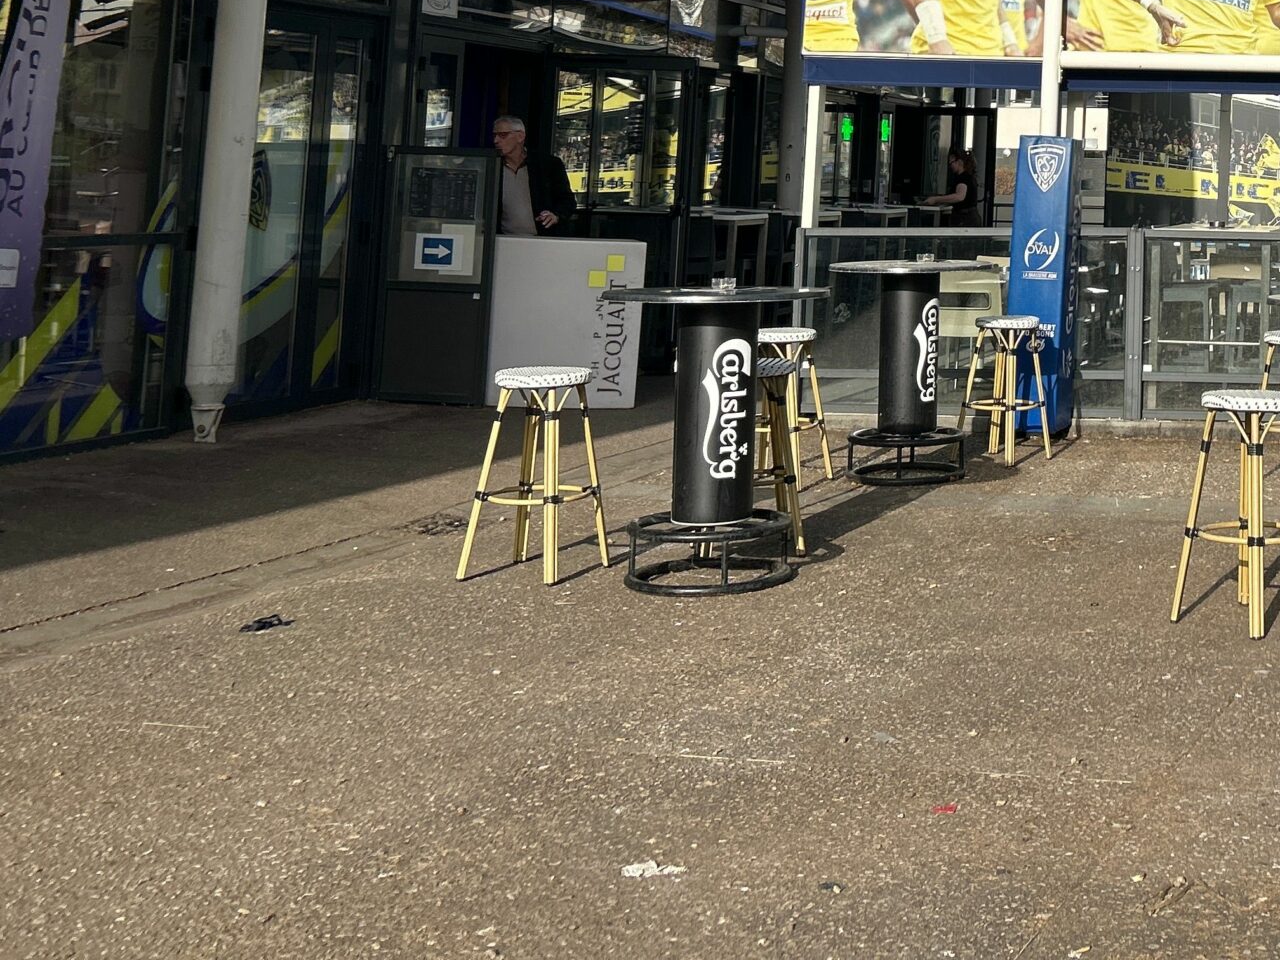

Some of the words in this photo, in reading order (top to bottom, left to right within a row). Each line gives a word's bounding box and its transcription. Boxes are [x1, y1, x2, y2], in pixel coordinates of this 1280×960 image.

[1027, 245, 1053, 255] OVAL
[914, 297, 940, 402] Carlsberg
[703, 338, 752, 479] Carlsberg
